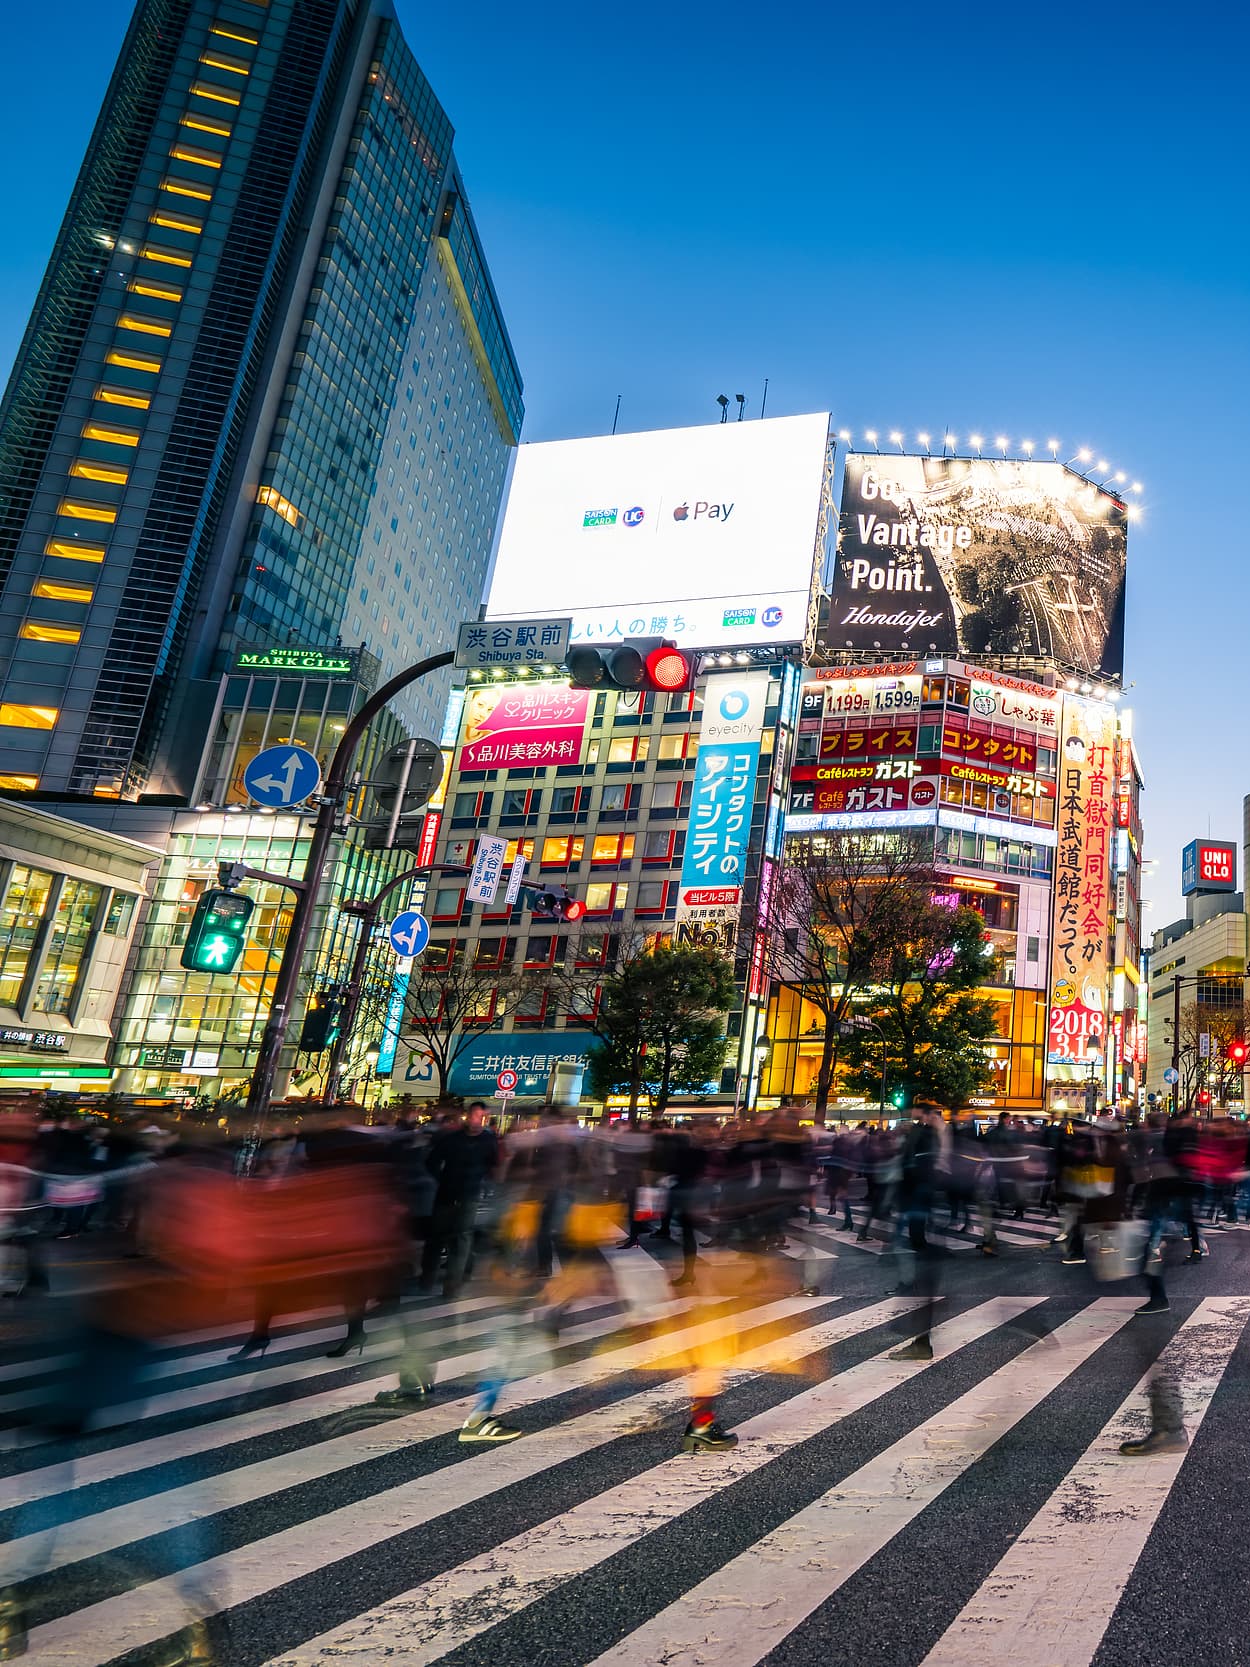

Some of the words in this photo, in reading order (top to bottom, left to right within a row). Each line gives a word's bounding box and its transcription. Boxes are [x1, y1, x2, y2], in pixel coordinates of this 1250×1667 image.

[584, 508, 618, 520] SAISON
[624, 508, 645, 523] UC
[694, 502, 734, 522] Pay
[588, 517, 613, 527] CARD
[858, 514, 972, 554] Vantage
[851, 559, 932, 592] Point.
[723, 608, 757, 619] SAISON
[727, 616, 752, 626] CARD
[763, 610, 784, 624] UC
[841, 605, 943, 633] HondaJet
[466, 625, 562, 649] 渋谷駅前
[240, 655, 298, 665] MARK
[303, 658, 349, 667] CITY
[270, 649, 323, 657] SHIBUYA
[479, 650, 521, 662] Shibuya
[526, 649, 547, 660] Sta.
[816, 662, 917, 679] しゃぶしゃぶバイキング
[522, 692, 584, 707] 品川スキン
[804, 696, 822, 707] 9F
[827, 694, 870, 713] 1,199円
[874, 691, 920, 712] 1,599円
[521, 706, 575, 721] クリニック
[1001, 697, 1055, 726] しゃぶ葉
[708, 723, 754, 737] eyecity
[823, 730, 913, 751] プライス
[944, 730, 1033, 764] コンタクト
[478, 741, 574, 762] 品川美容外科
[875, 760, 922, 780] ガスト
[1006, 774, 1049, 797] ガスト
[792, 793, 814, 808] 7F
[819, 791, 844, 803] Café
[846, 786, 903, 811] ガスト
[914, 791, 934, 799] ガスト
[693, 755, 728, 875] アイシティ
[720, 755, 750, 873] コンタクトの
[1081, 741, 1110, 962] 打首獄門同好会が
[1204, 851, 1227, 864] UNI
[480, 842, 503, 898] 渋谷駅前
[1057, 769, 1084, 974] 日本武道館だって。
[1204, 865, 1229, 878] QLO
[690, 892, 735, 903] 当ビル5階
[676, 920, 736, 949] No.1
[1051, 1009, 1102, 1036] 2018
[35, 1033, 66, 1046] 渋谷駅
[469, 1073, 499, 1081] SUMITOM
